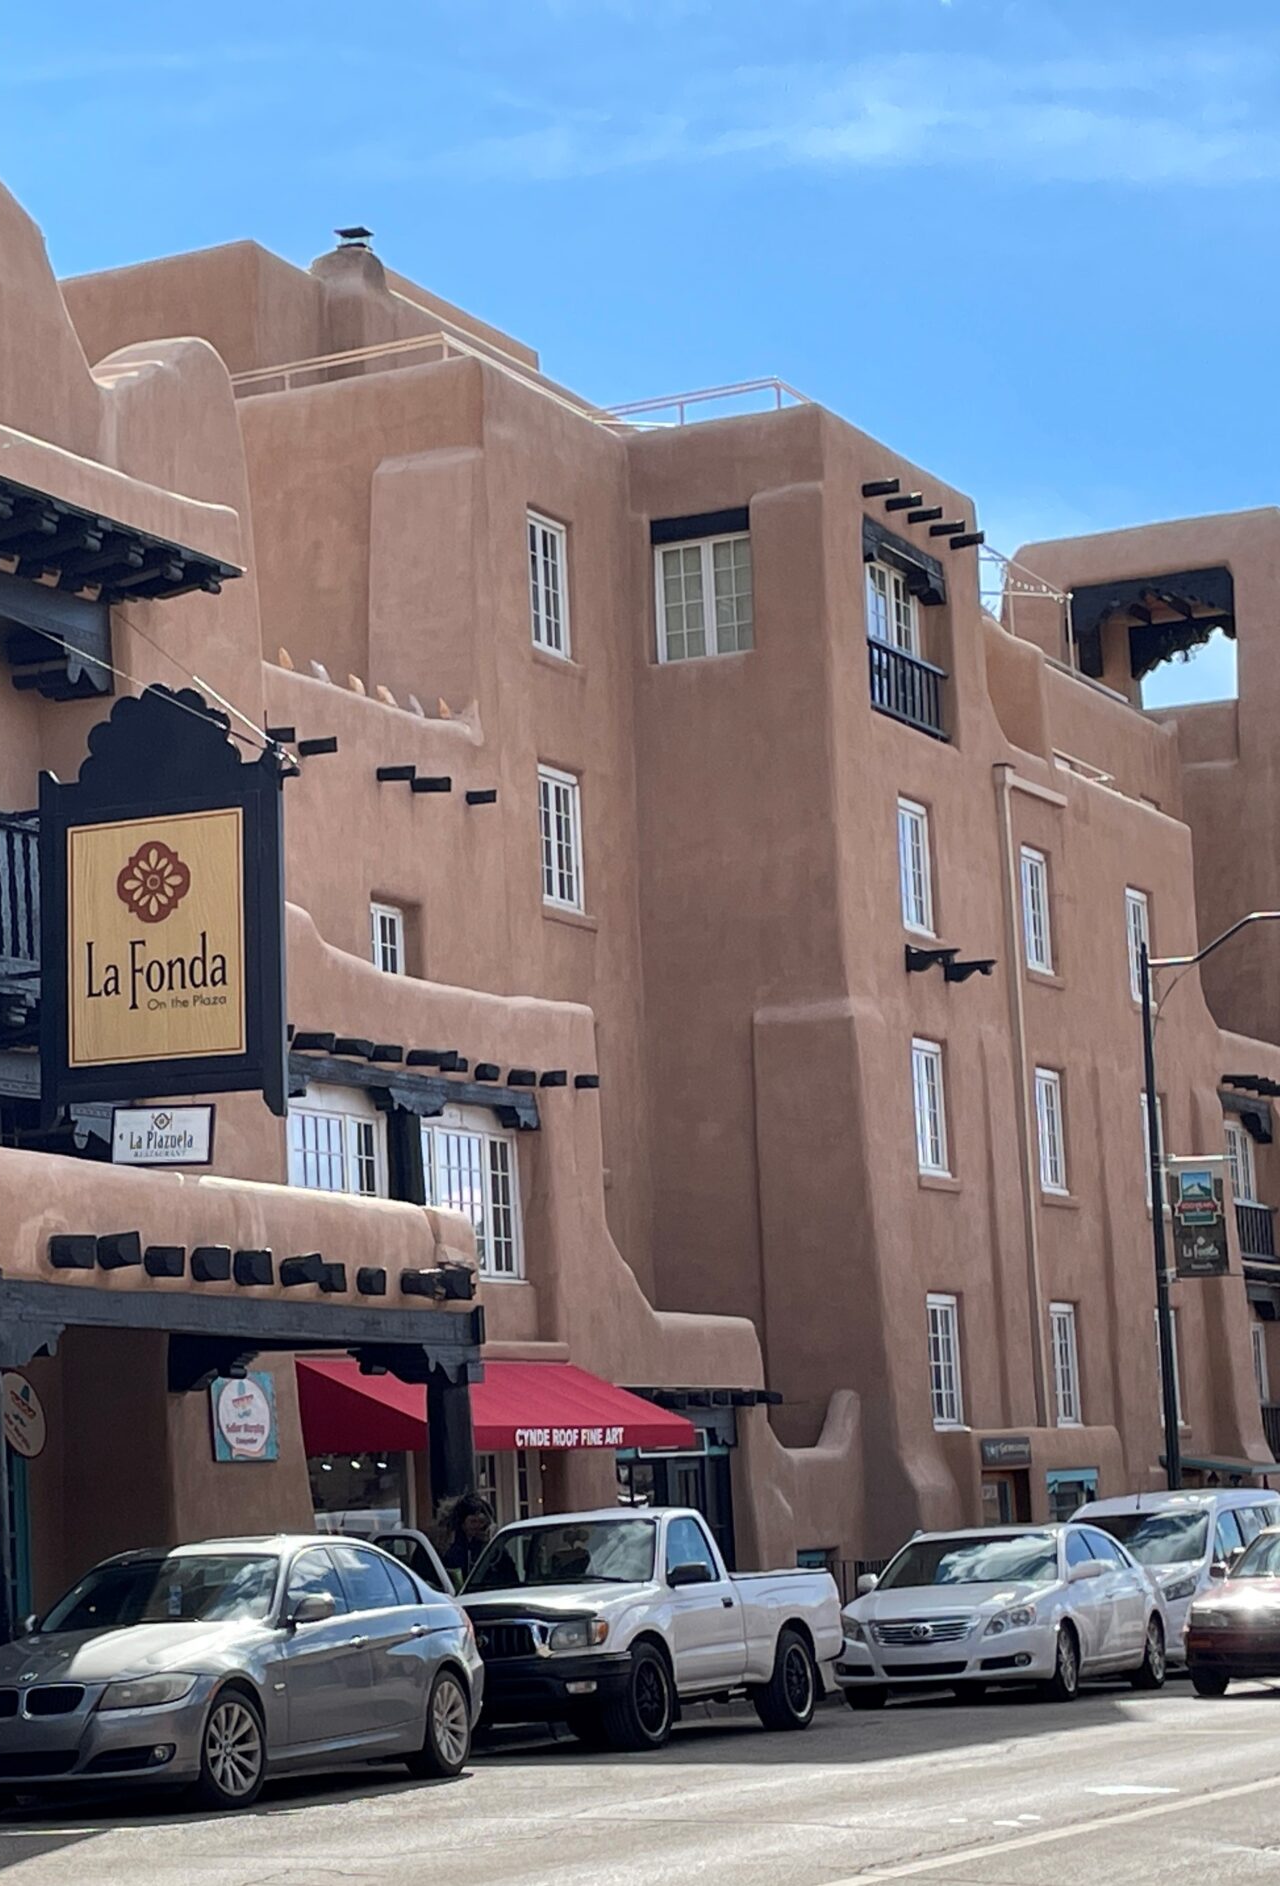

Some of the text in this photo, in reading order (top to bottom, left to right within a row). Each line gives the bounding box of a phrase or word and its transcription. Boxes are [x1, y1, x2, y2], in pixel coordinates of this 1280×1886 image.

[86, 931, 228, 1010] La Fonda
[147, 994, 227, 1011] On the Plaza
[130, 1130, 193, 1150] La Plazuela
[515, 1427, 624, 1447] CYNDE ROOF FINE ART
